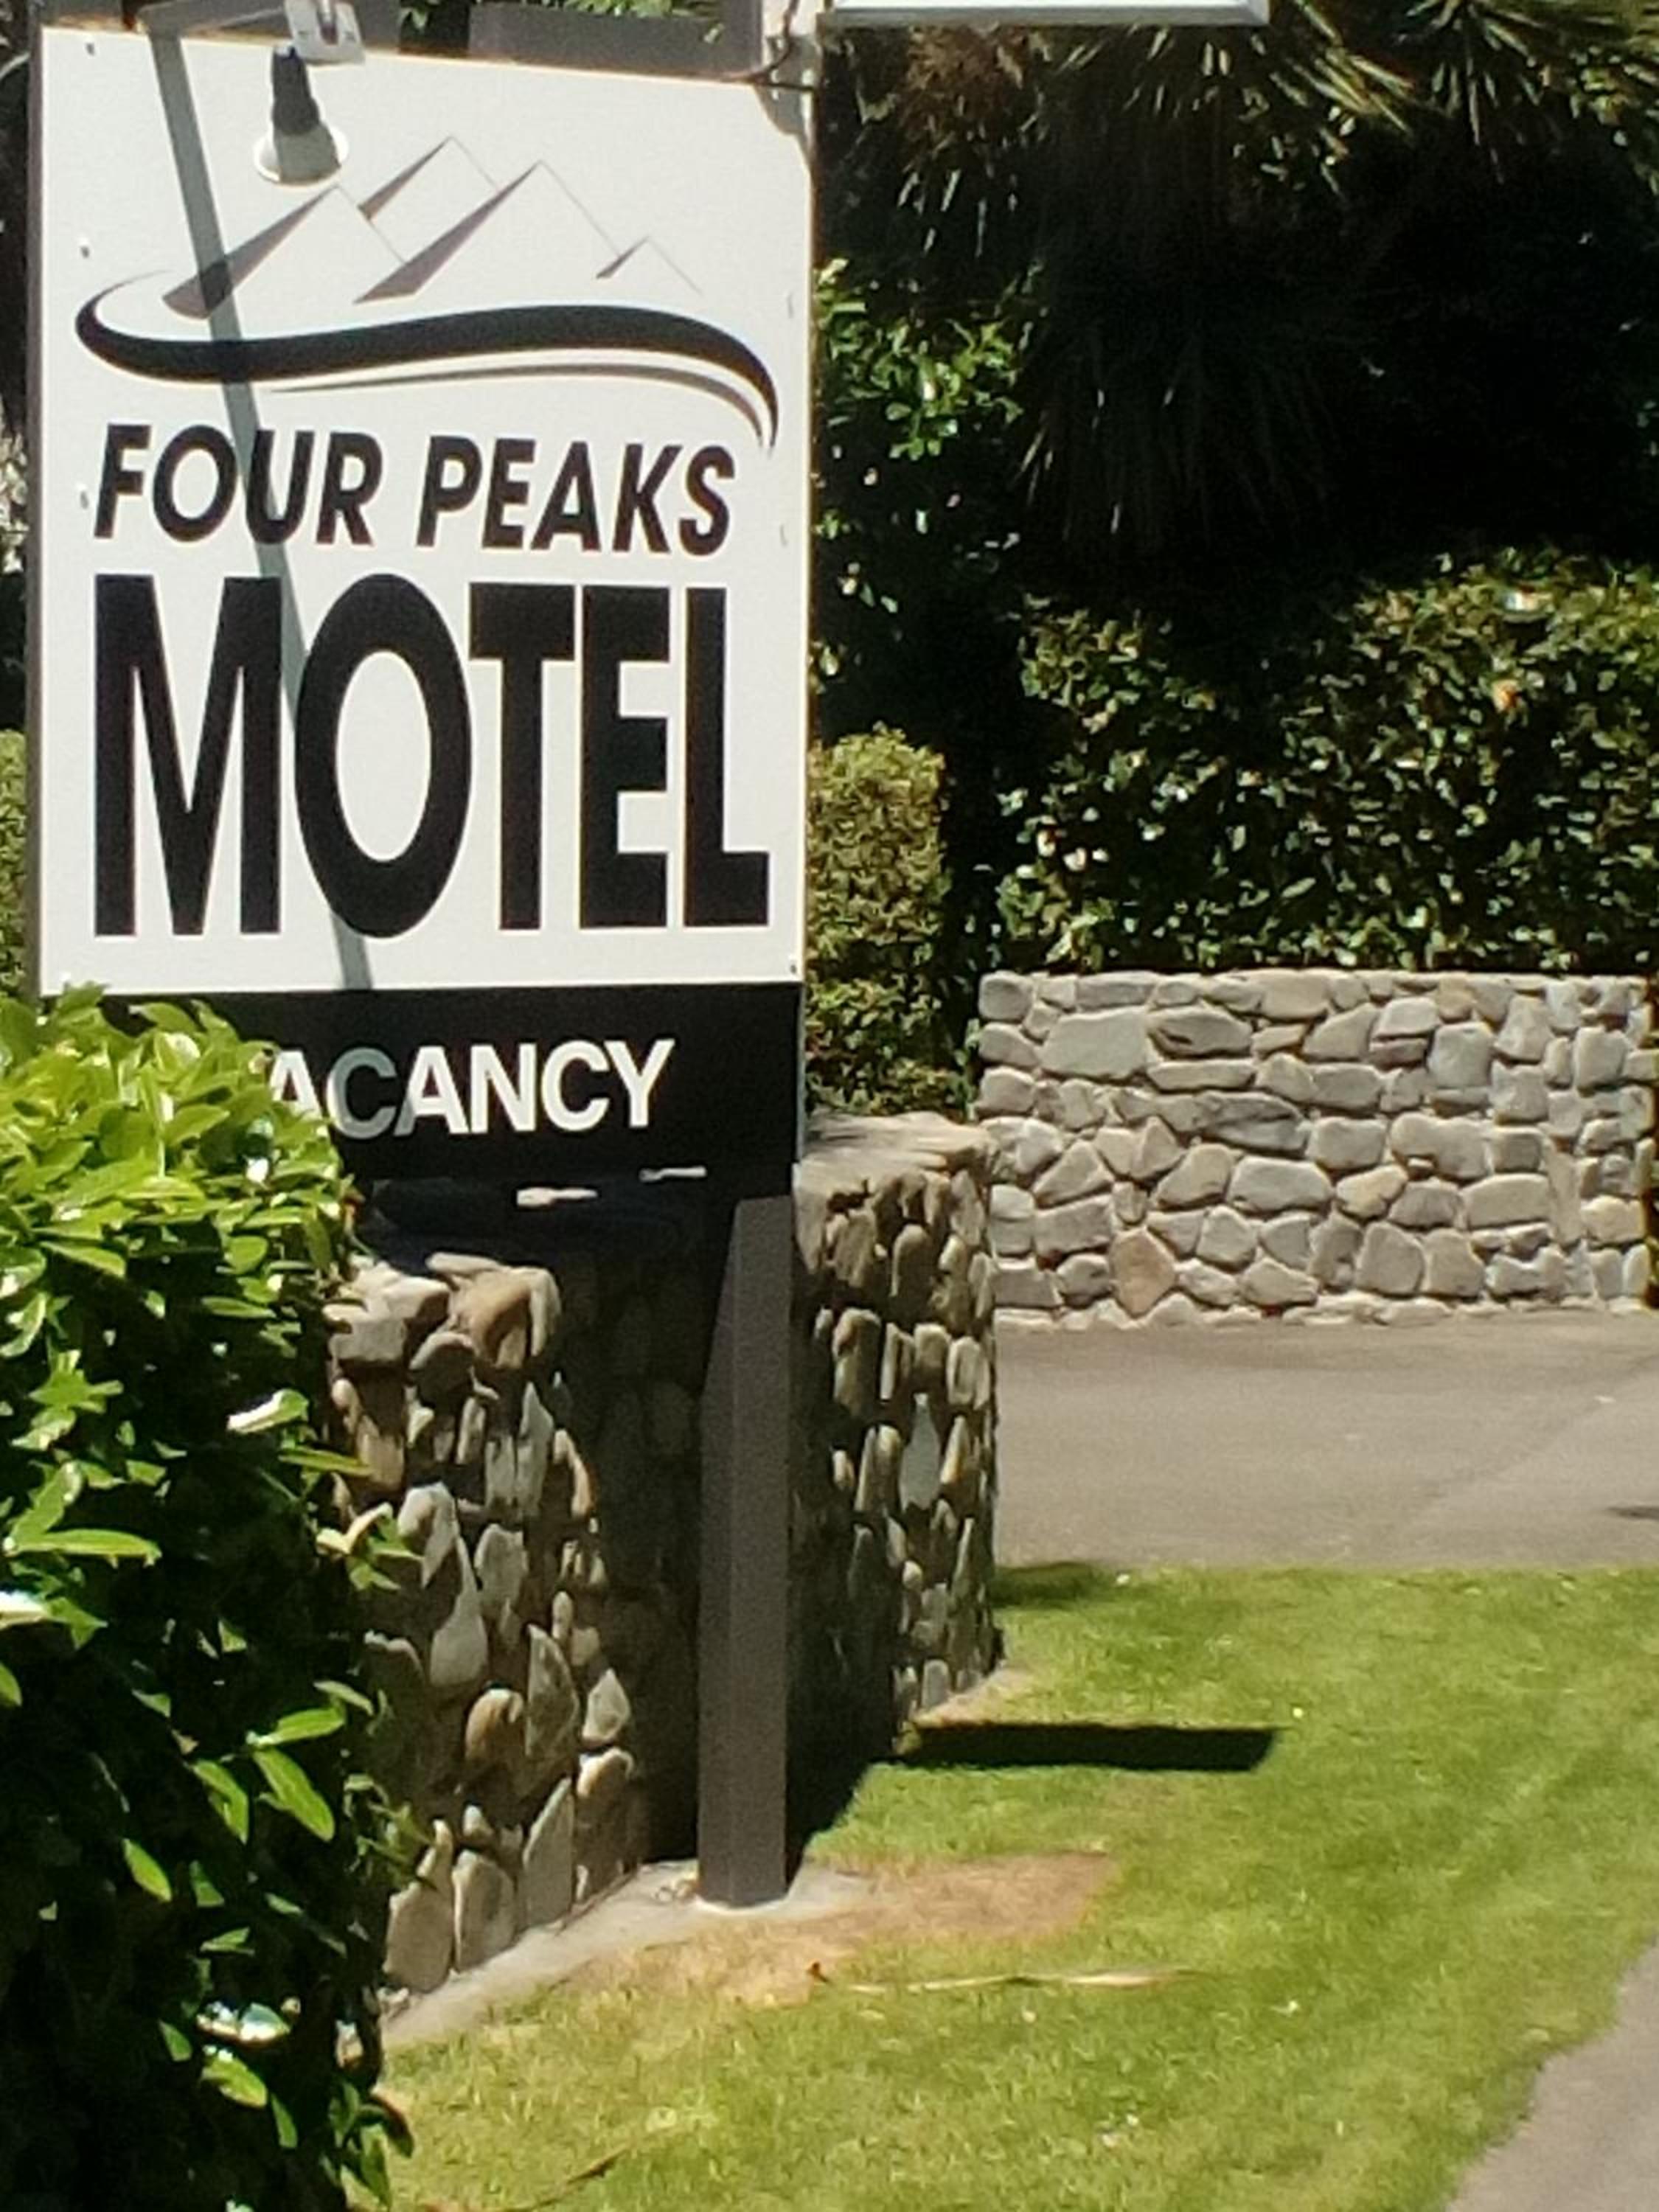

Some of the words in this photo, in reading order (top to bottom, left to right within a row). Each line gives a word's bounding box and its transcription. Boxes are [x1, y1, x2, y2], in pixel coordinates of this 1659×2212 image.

[94, 423, 383, 544] FOUR
[417, 437, 734, 555] PEAKS
[95, 574, 769, 938] MOTEL
[270, 1040, 675, 1139] ACANCY
